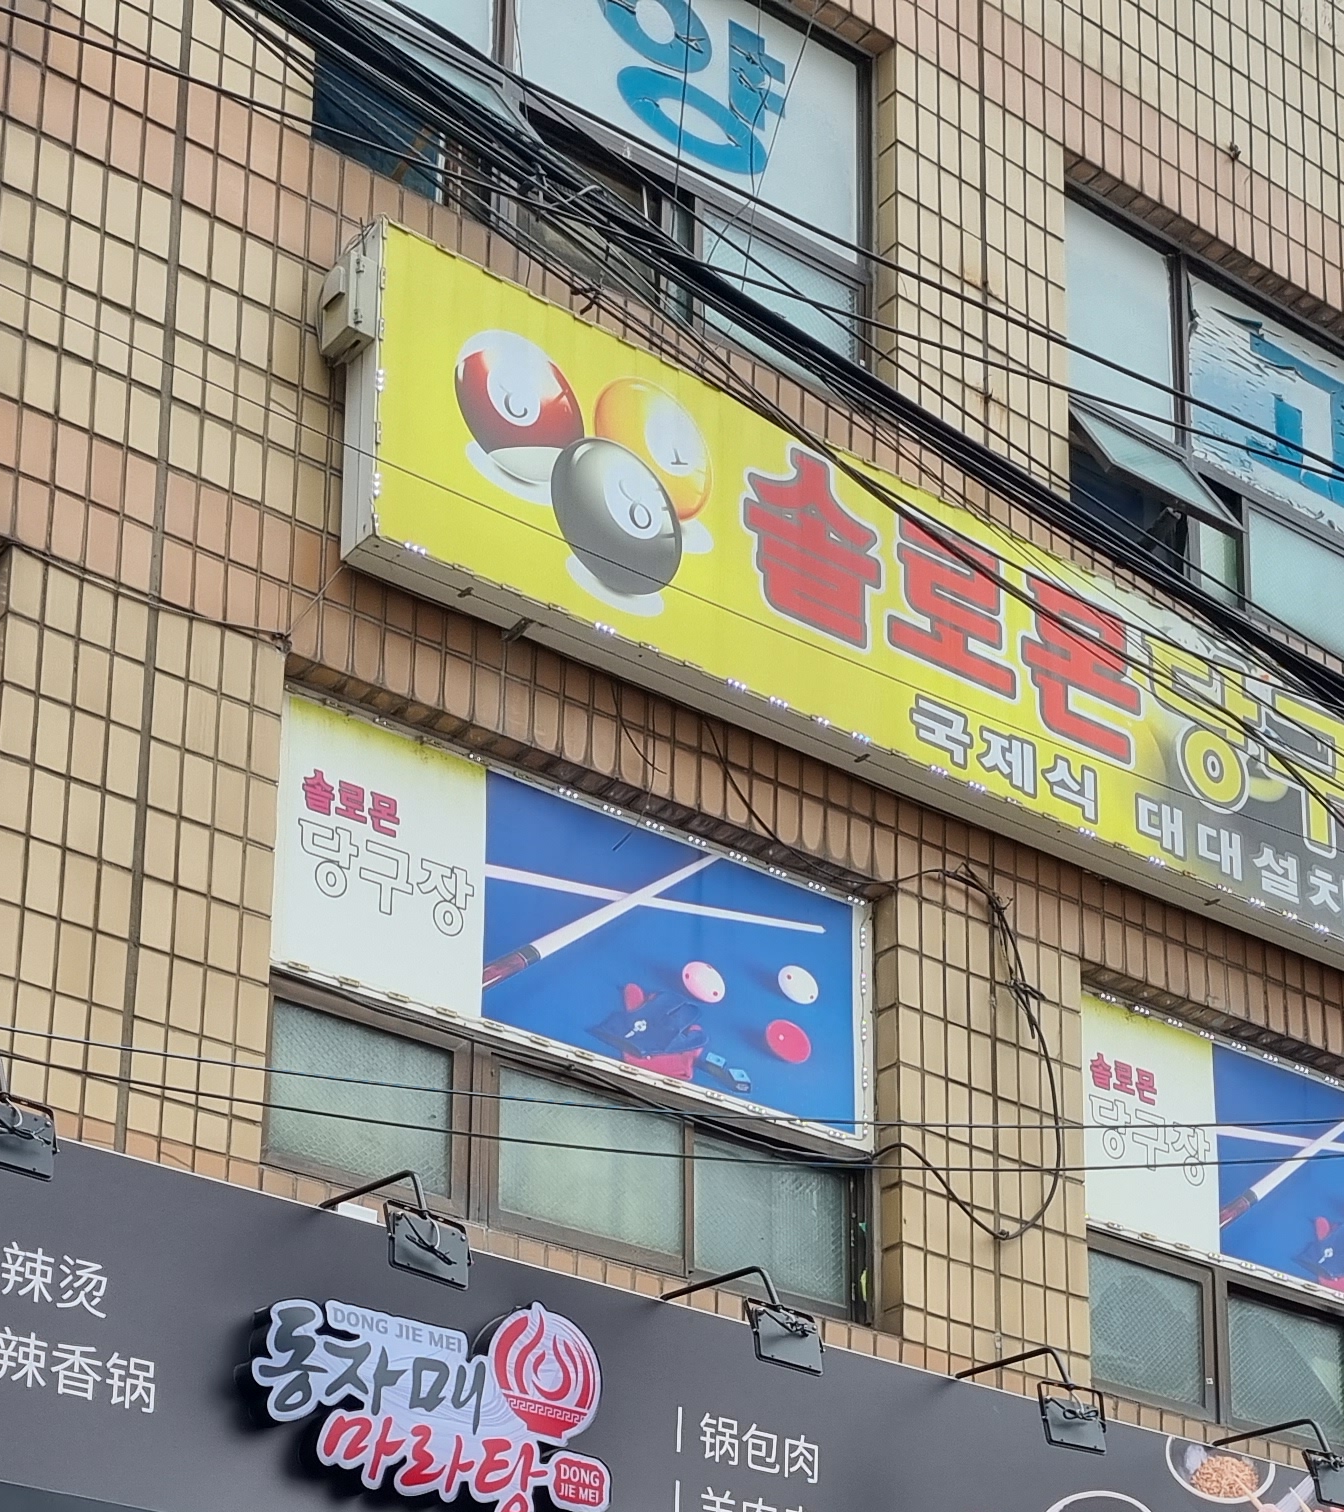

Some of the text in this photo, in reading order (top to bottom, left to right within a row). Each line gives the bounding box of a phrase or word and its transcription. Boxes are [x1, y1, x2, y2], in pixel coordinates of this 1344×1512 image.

[744, 447, 1143, 768] 솔로몬
[912, 695, 1100, 822] 국제식
[302, 768, 401, 838] 솔로몬
[298, 818, 475, 937] 당구장
[1089, 1052, 1158, 1106] 솔로몬
[1088, 1094, 1212, 1187] 당구장
[331, 1306, 464, 1354] DONG JIE MEI
[258, 1305, 487, 1434] 동자매
[557, 1461, 601, 1488] DONG
[699, 1410, 821, 1485] 锅包肉
[557, 1483, 601, 1504] JIE MEI
